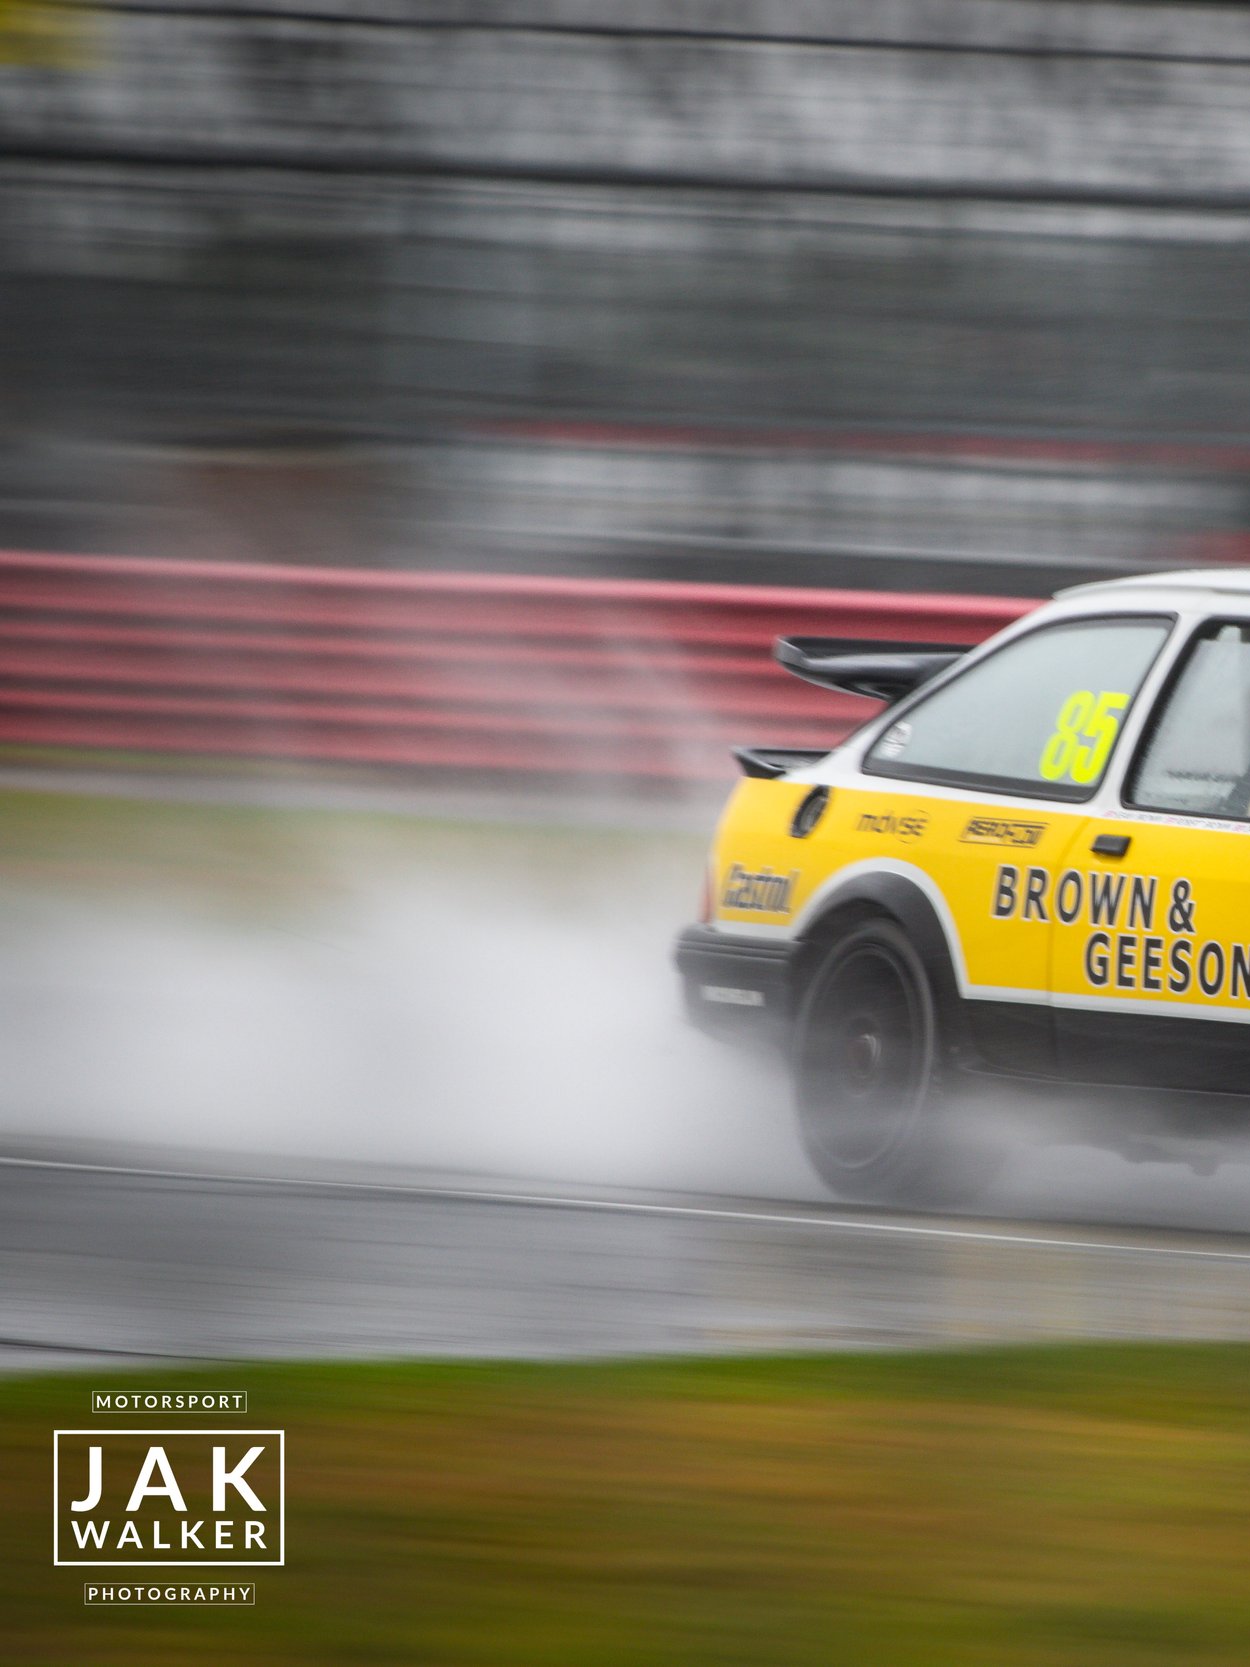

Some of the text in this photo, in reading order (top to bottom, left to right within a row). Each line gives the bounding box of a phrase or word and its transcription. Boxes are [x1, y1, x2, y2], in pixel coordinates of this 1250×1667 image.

[1038, 690, 1131, 784] 85
[990, 864, 1196, 936] BROWN &
